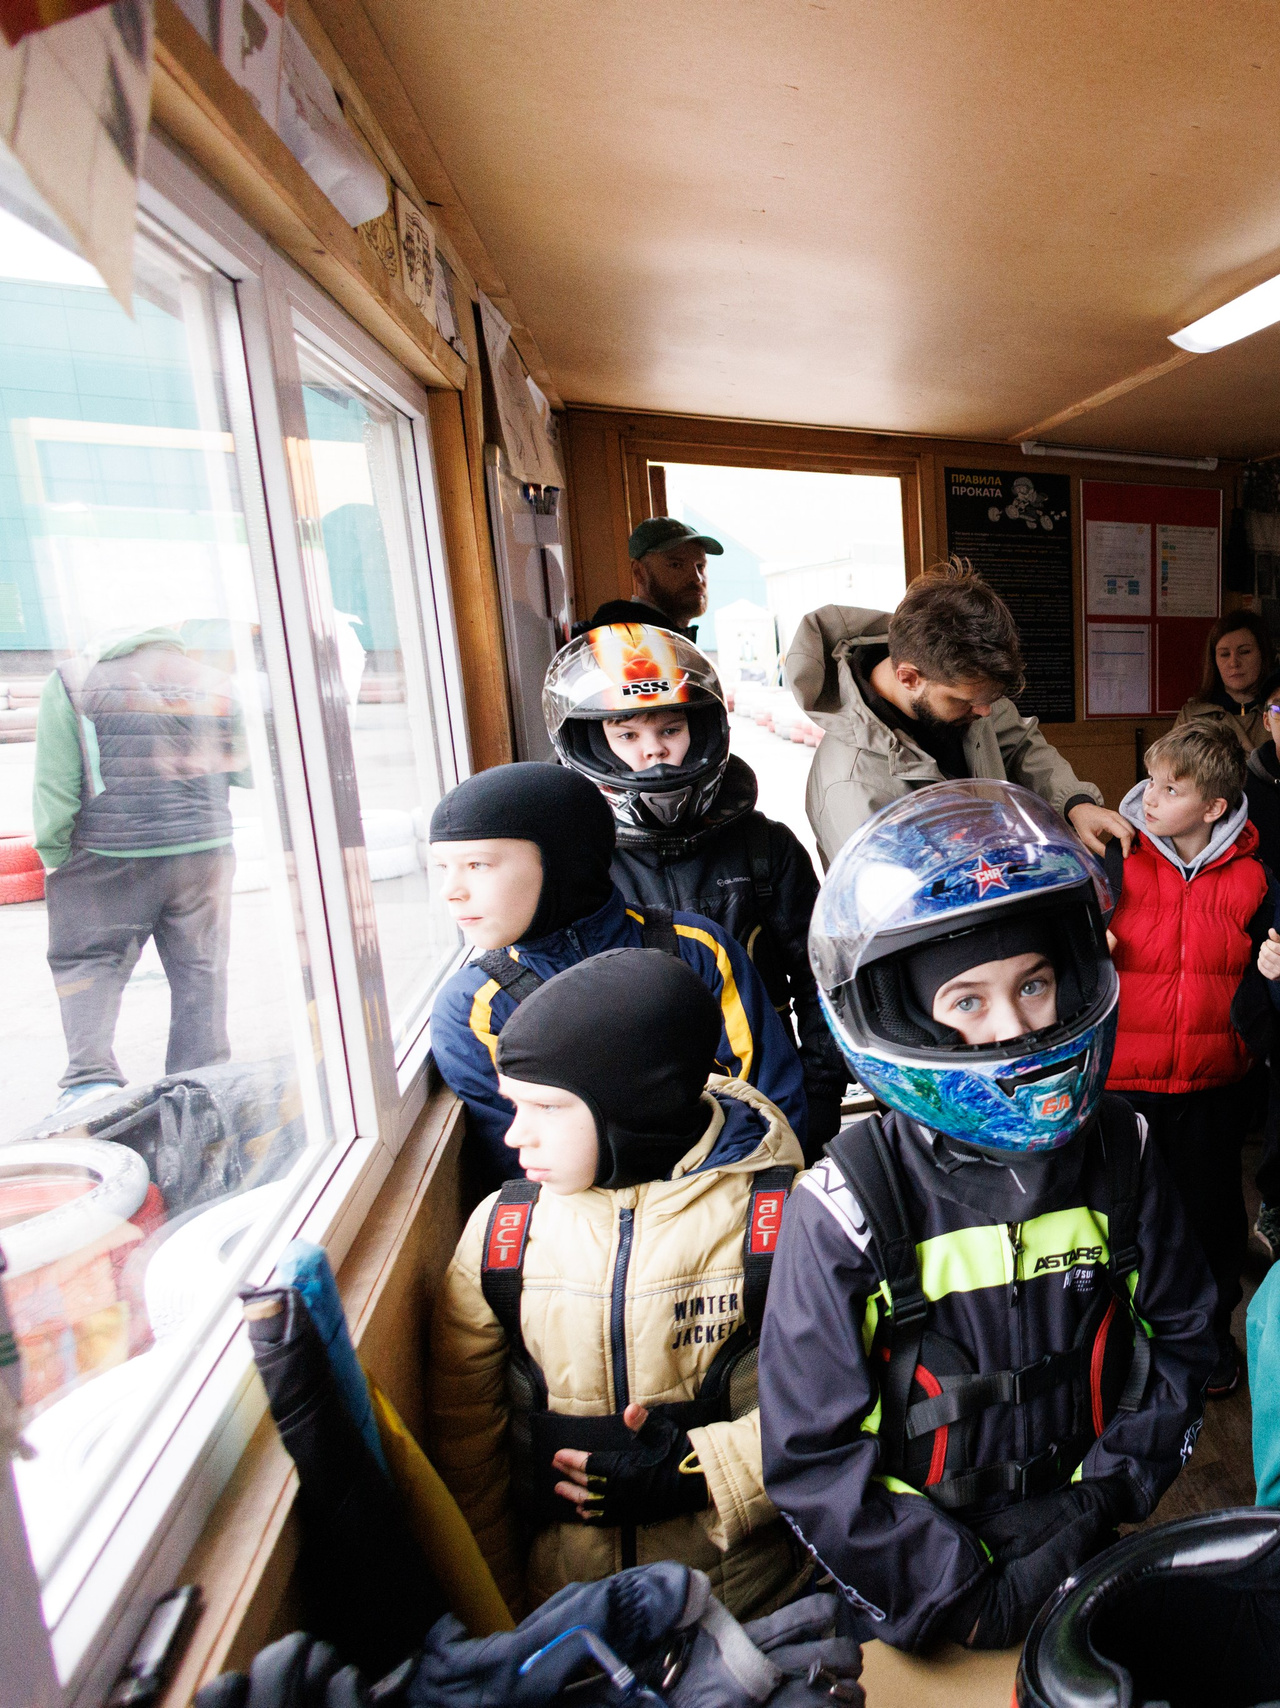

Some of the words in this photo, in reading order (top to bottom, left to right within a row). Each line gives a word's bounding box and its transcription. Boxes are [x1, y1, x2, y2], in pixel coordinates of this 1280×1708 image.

[951, 473, 1003, 486] ПРАВИЛА
[951, 485, 1004, 498] ПРОКАТА
[1033, 1245, 1103, 1274] ASTARS
[674, 1292, 738, 1321] WINTER
[672, 1320, 737, 1350] JACKET
